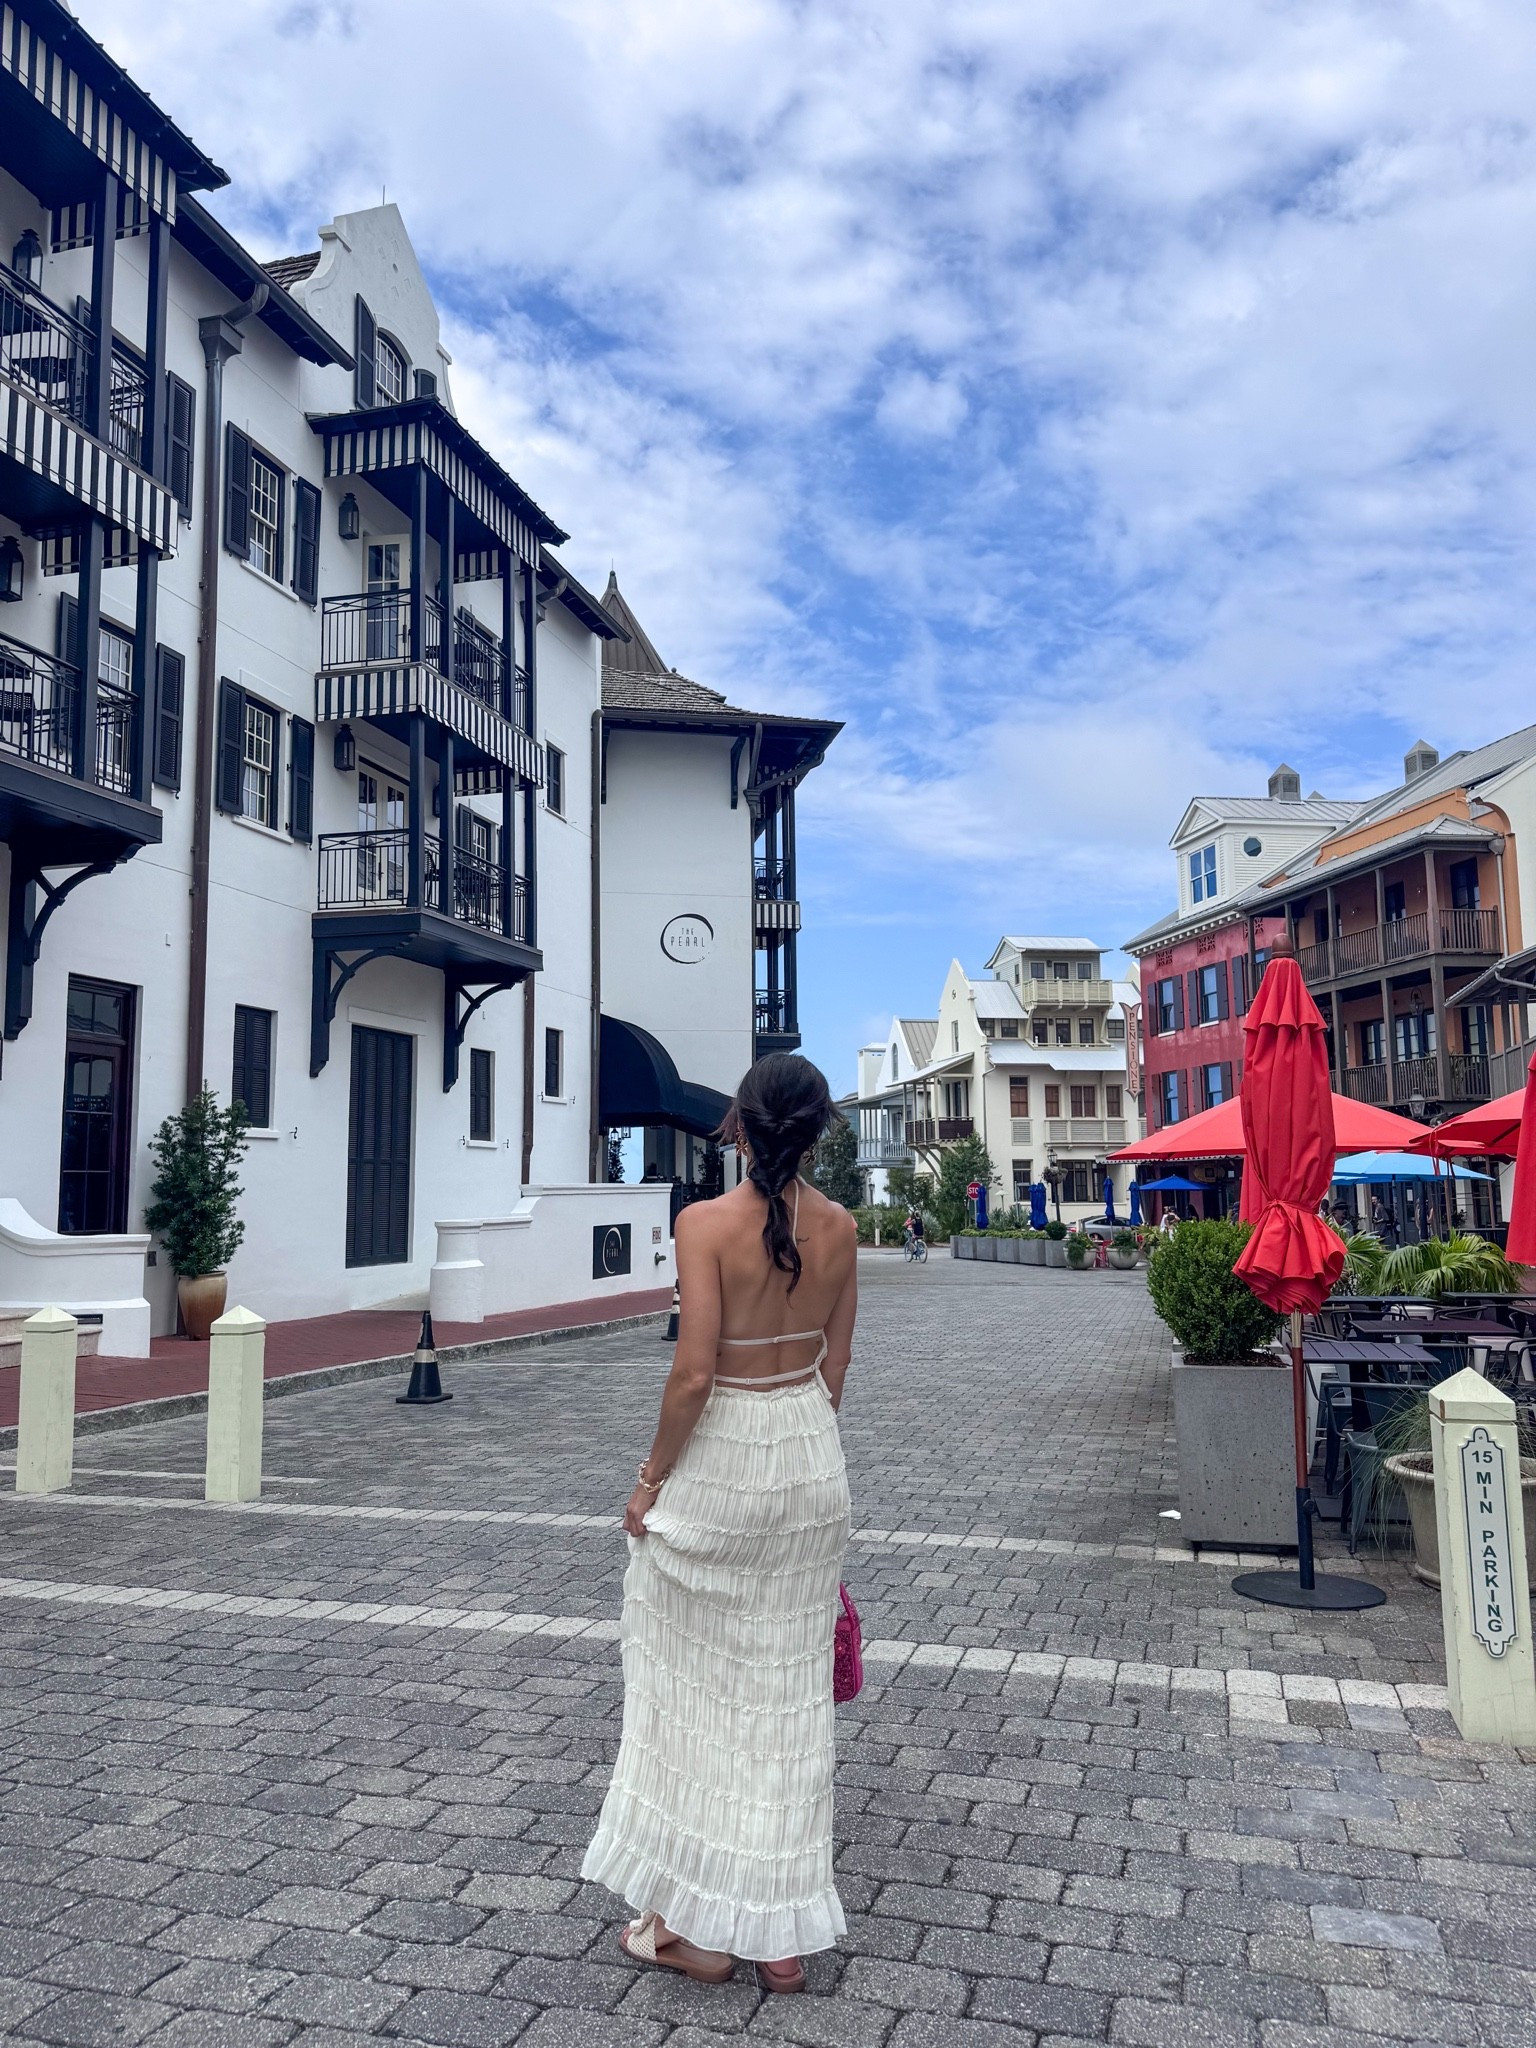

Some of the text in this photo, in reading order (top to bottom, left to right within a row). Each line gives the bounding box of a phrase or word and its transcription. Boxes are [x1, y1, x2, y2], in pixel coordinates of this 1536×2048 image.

[681, 927, 694, 936] THE
[670, 936, 705, 947] PEARL
[1129, 1012, 1138, 1089] PENSIONE
[968, 1187, 979, 1195] STO
[1471, 1450, 1502, 1632] 15 MIN PARKING
